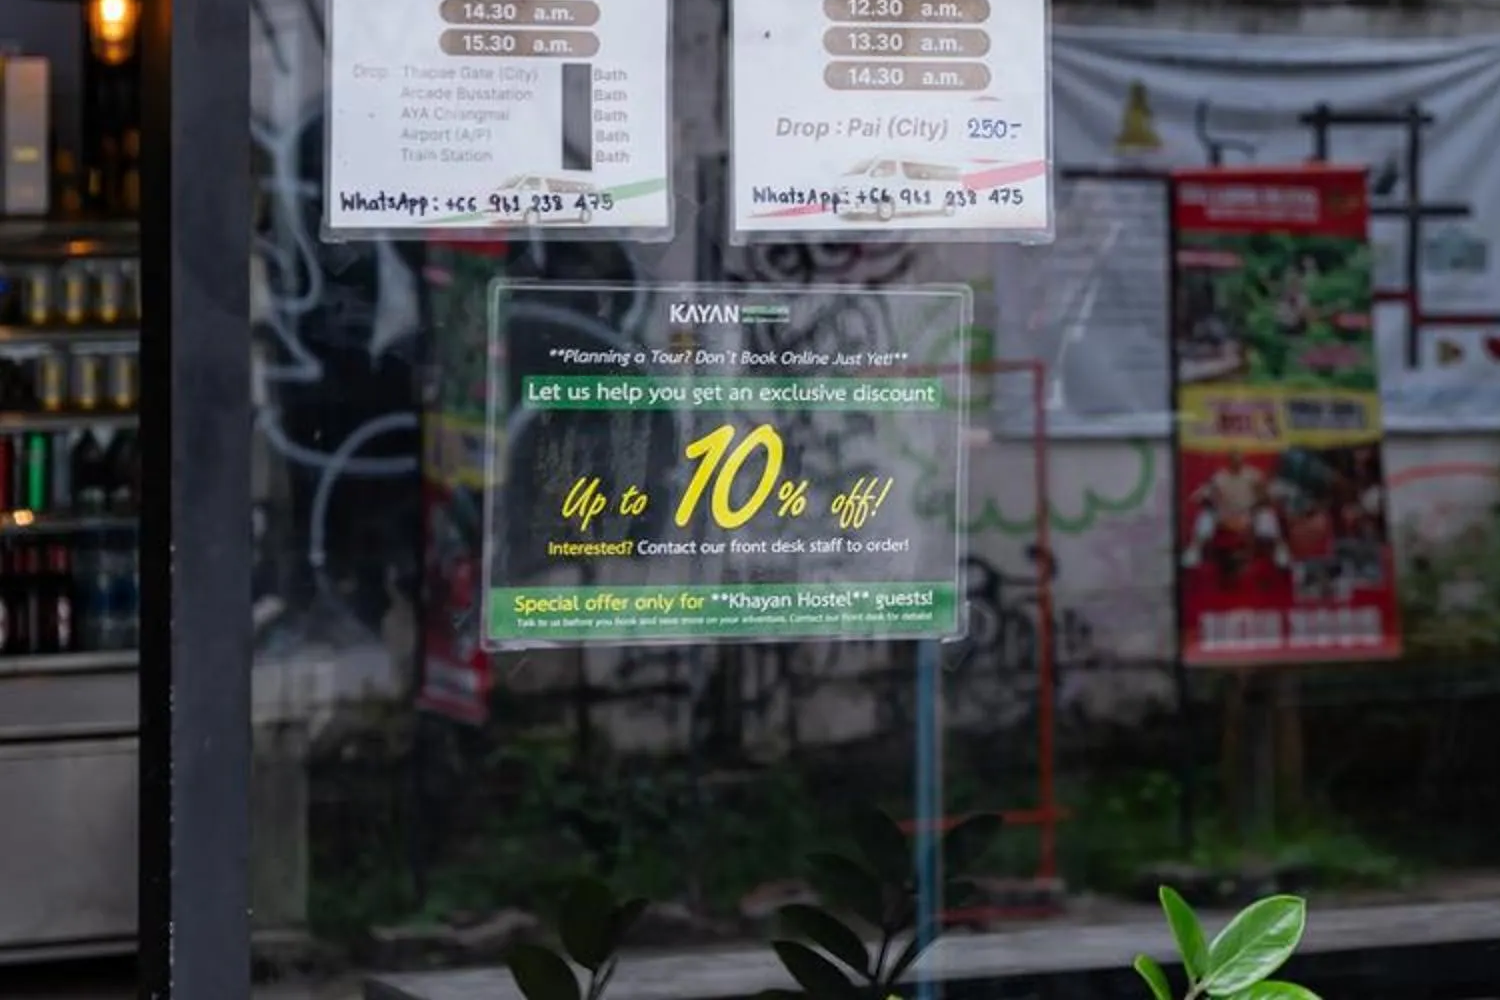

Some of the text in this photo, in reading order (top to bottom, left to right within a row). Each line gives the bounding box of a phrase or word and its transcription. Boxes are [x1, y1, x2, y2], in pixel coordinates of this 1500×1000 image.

[463, 4, 574, 22] 14.30 a.m.
[848, 0, 963, 17] 12.30 a.m.
[462, 35, 573, 53] 15.30 a.m.
[848, 33, 963, 52] 13.30 a.m.
[460, 66, 493, 80] Gate
[848, 68, 964, 86] 14.30 a.m.
[400, 87, 452, 100] Arcade
[401, 107, 429, 119] AYA
[401, 128, 450, 142] Airport
[776, 117, 949, 141] Drop Pai (City)
[402, 148, 437, 162] Train
[440, 149, 493, 163] Station
[669, 304, 739, 323] KAYAN
[634, 353, 645, 364] a
[650, 350, 692, 364] Tour?
[741, 351, 776, 365] Book
[780, 351, 829, 365] Online
[832, 352, 861, 365] Just
[529, 383, 936, 405] Let us help you get an exclusive discount
[561, 477, 607, 531] Up
[619, 484, 648, 515] to
[830, 477, 894, 529] off!
[547, 538, 910, 556] Interested? Contact our front desk staff to order!
[514, 595, 579, 614] Special
[585, 594, 629, 611] offer
[635, 594, 674, 614] only
[679, 593, 705, 610] for
[875, 590, 933, 609] guests!
